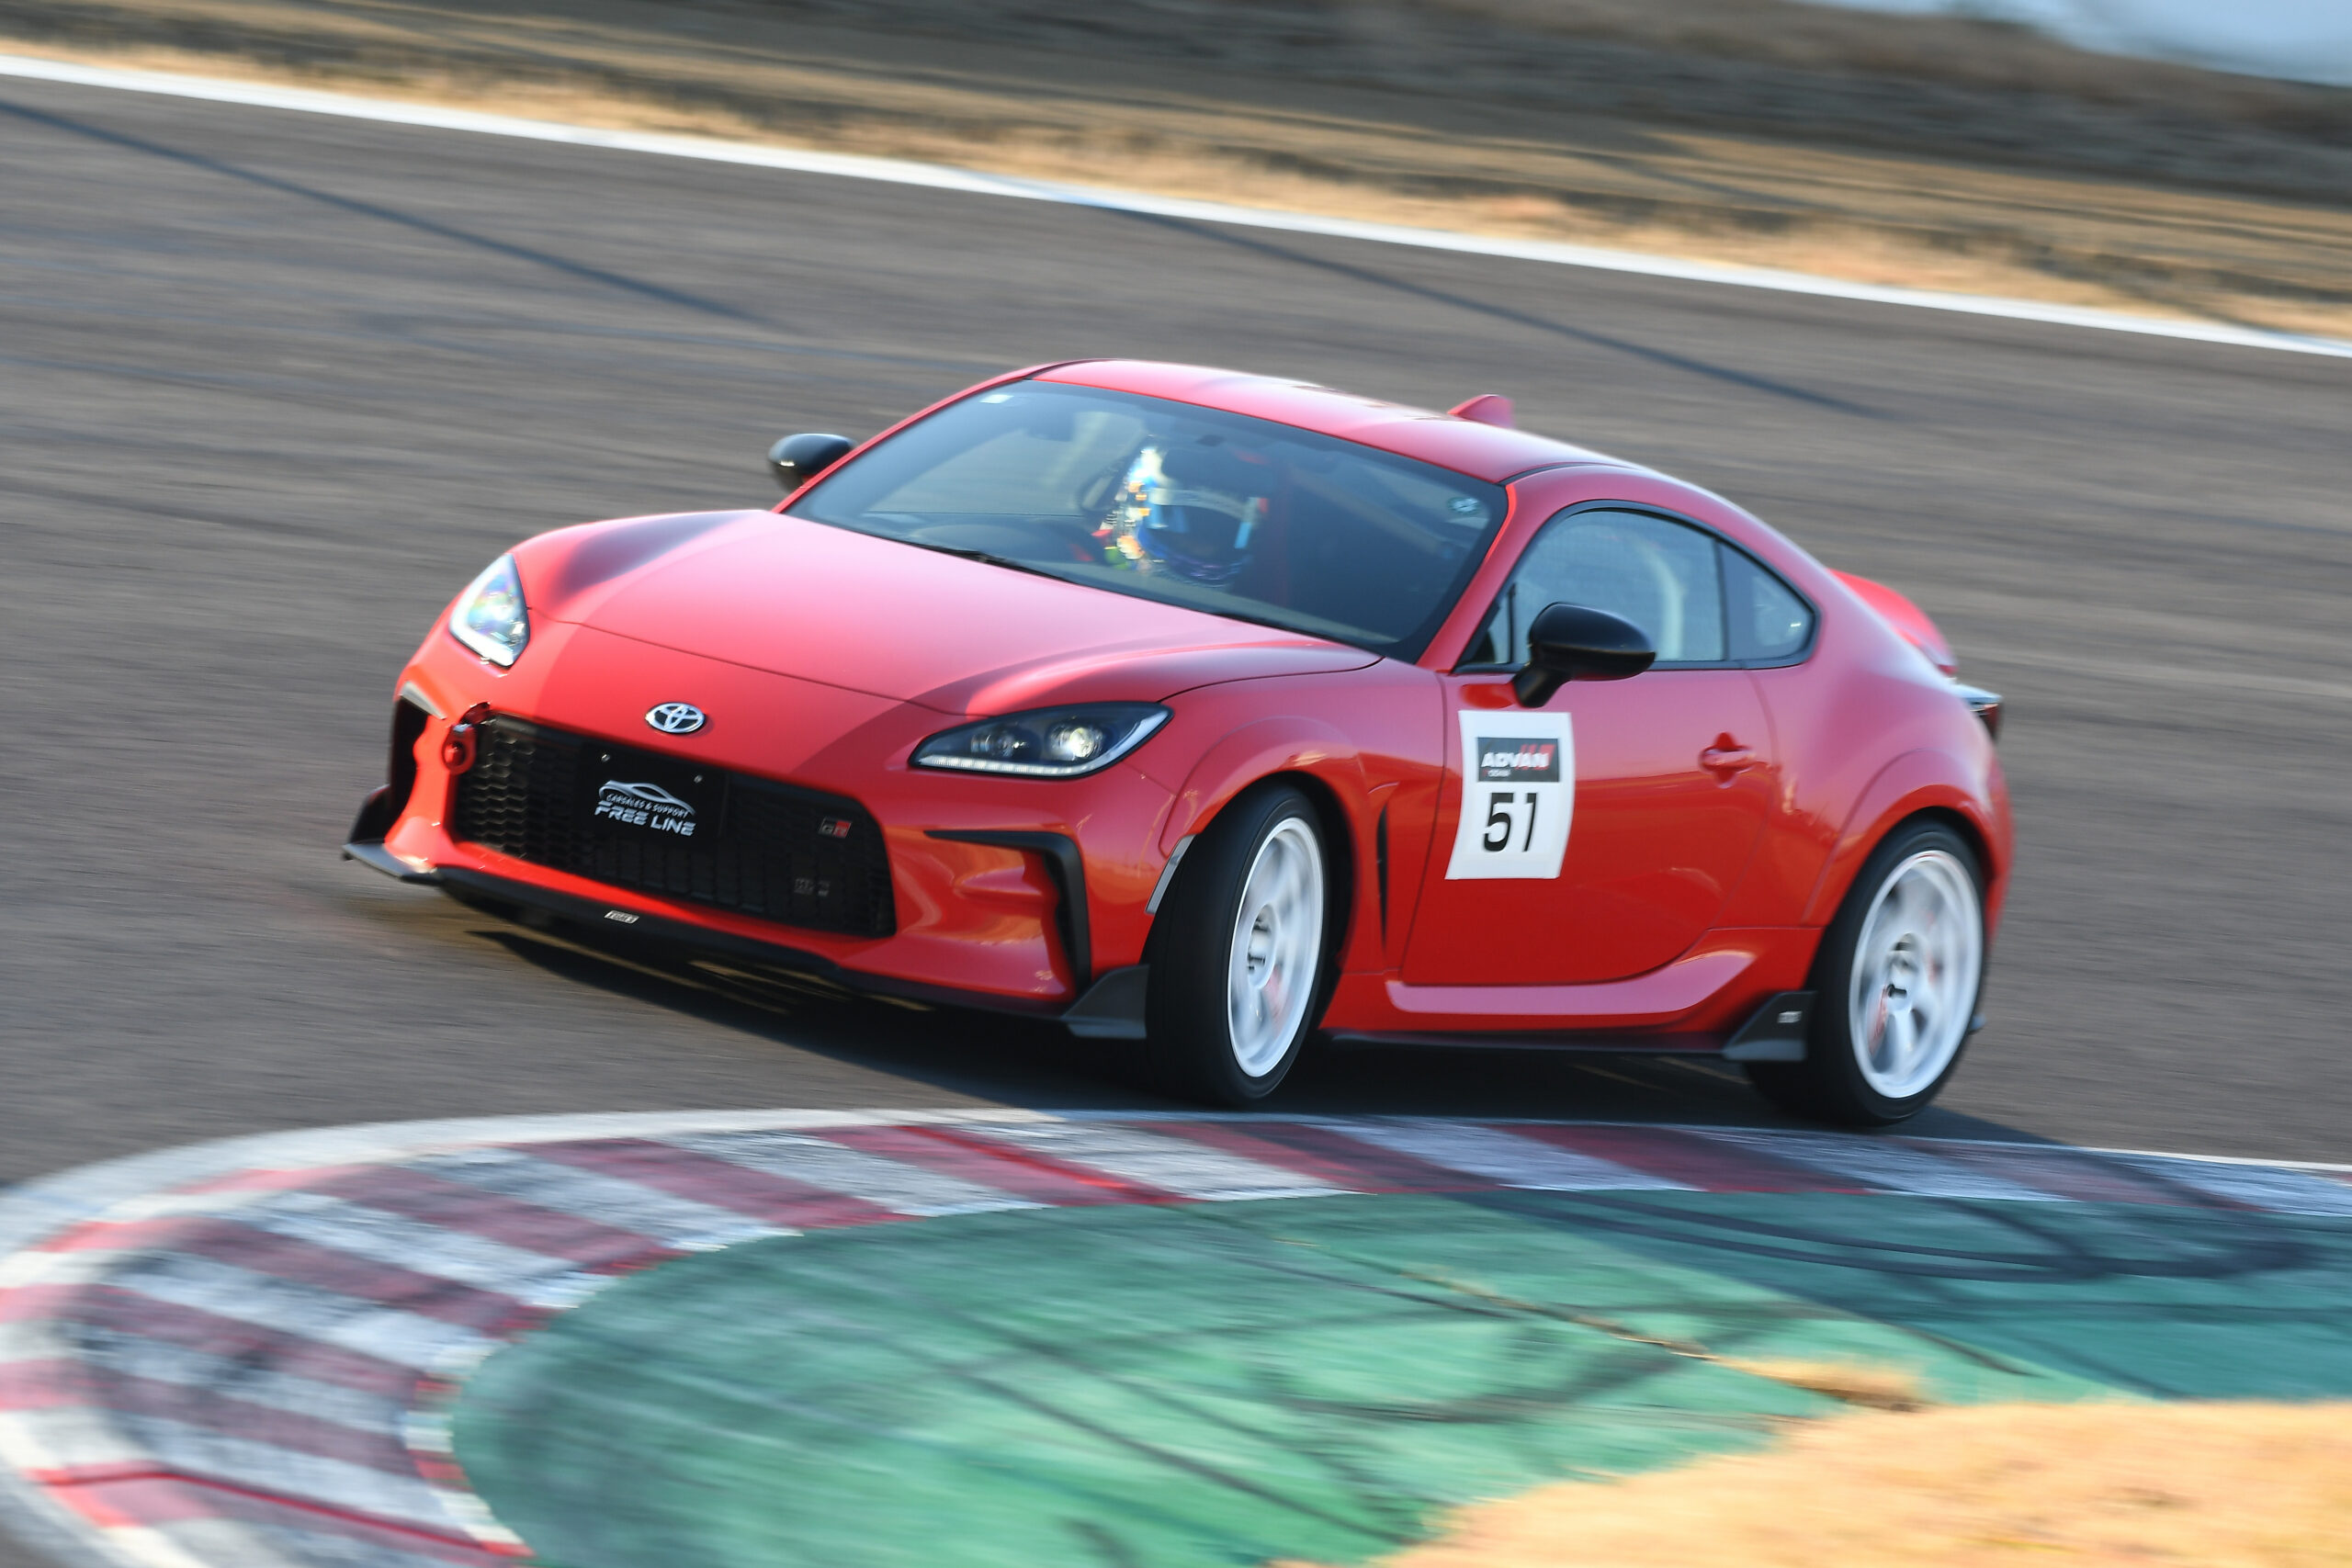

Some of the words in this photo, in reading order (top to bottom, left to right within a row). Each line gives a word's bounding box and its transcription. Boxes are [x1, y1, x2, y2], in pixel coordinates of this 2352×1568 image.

[1481, 751, 1550, 768] ADVAN
[594, 800, 650, 826] FREE
[650, 815, 696, 836] LINE
[652, 803, 689, 819] SUPPORT
[1484, 792, 1538, 852] 51
